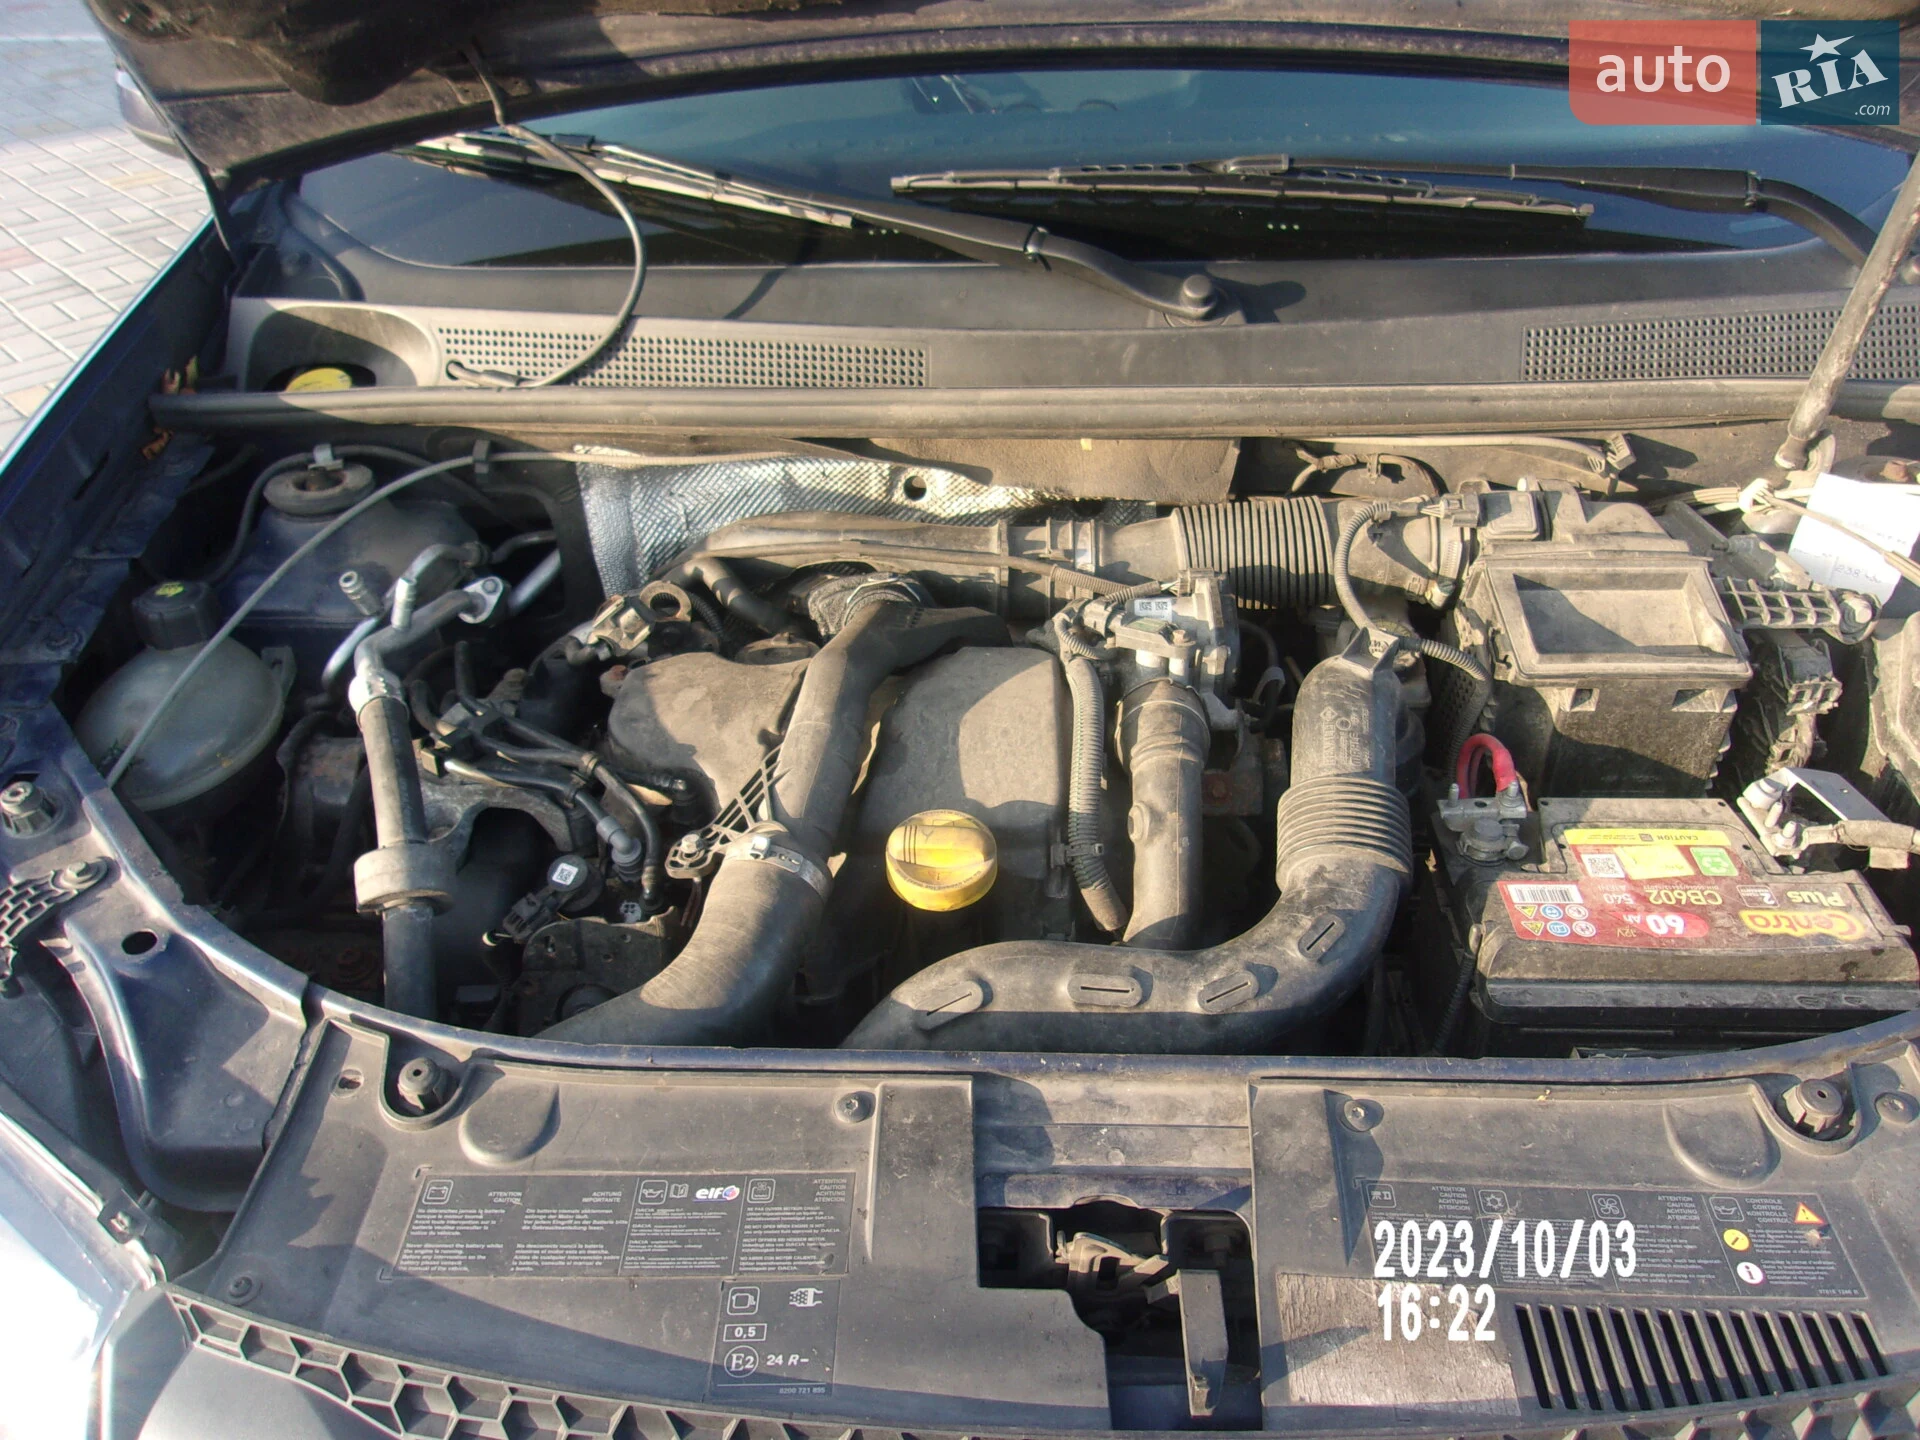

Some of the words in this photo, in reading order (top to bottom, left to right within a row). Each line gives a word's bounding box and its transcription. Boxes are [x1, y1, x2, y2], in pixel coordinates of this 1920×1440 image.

[1603, 892, 1635, 905] 540
[1644, 889, 1723, 906] CB602
[1786, 890, 1847, 907] Plus
[1623, 914, 1643, 924] Ah
[1645, 914, 1685, 935] 60
[1748, 913, 1857, 936] Centra
[695, 1187, 724, 1199] elf
[734, 1326, 756, 1338] 0,5
[730, 1353, 755, 1371] E2
[766, 1354, 783, 1366] 24
